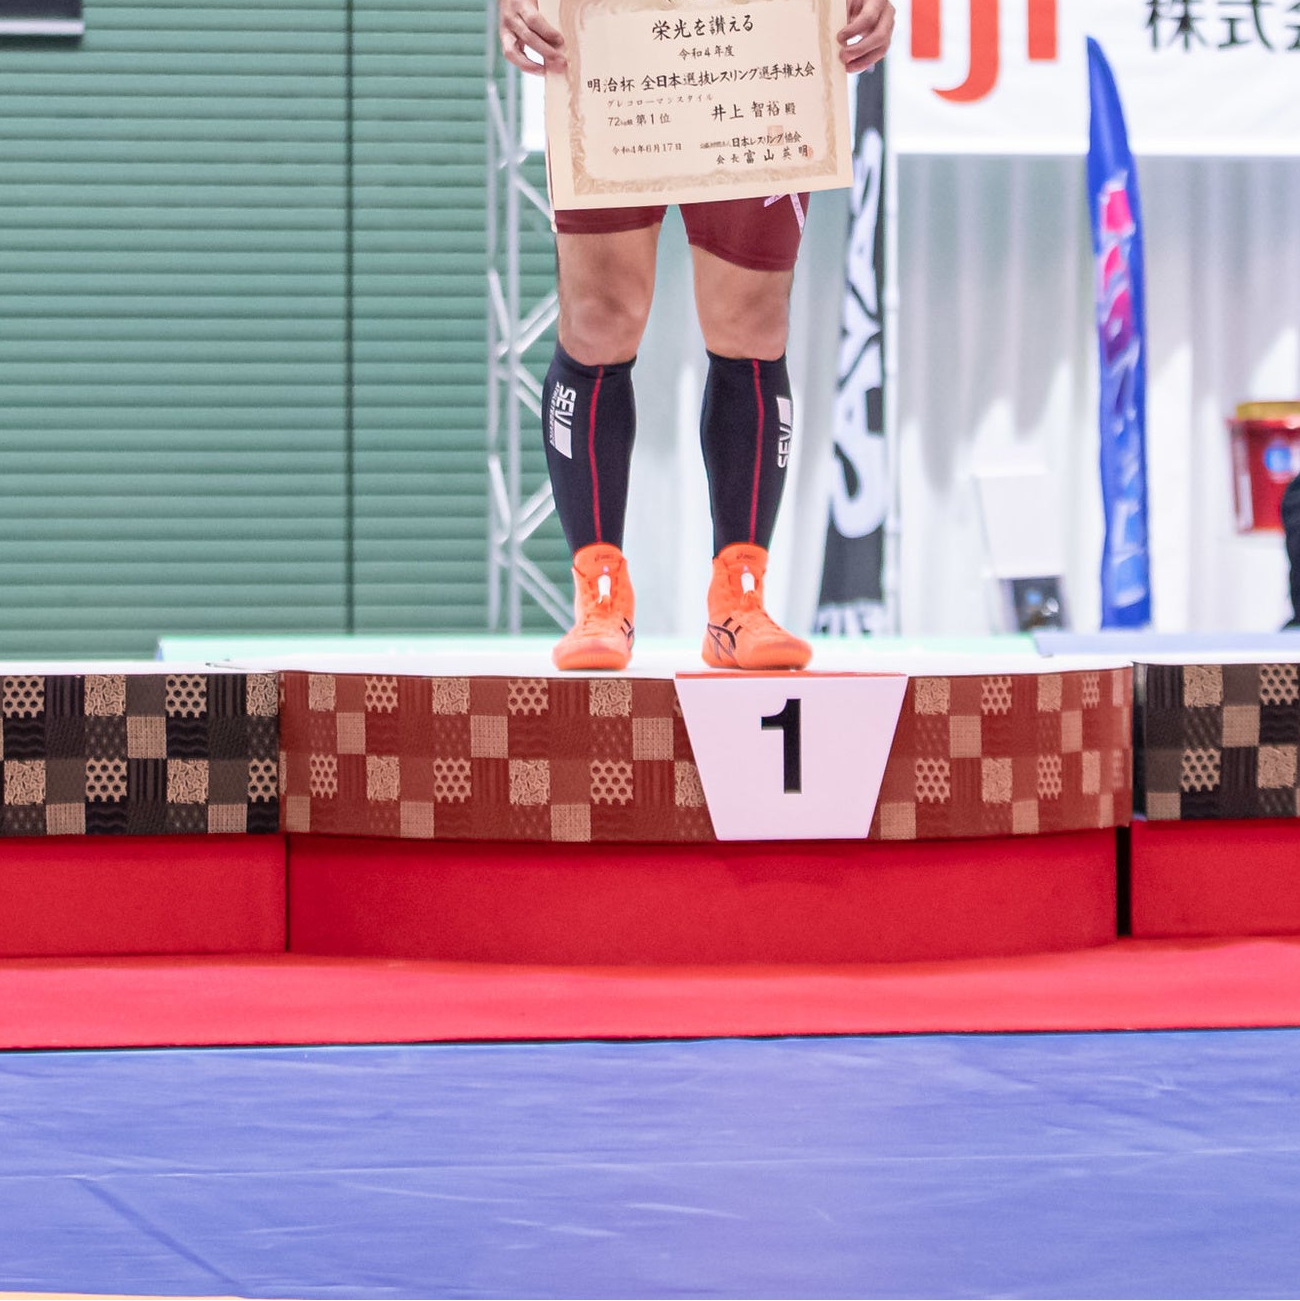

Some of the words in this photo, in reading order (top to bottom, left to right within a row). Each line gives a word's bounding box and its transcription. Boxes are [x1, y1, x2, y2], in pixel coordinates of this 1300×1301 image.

[651, 14, 754, 42] 栄光を讃える
[678, 44, 735, 61] 令和4年度
[586, 75, 636, 94] 明治杯
[641, 61, 815, 91] 全日本選抜レスリング選手権大会
[711, 102, 745, 122] 井上
[751, 100, 781, 117] 智裕
[555, 385, 578, 425] SEV
[761, 698, 802, 794] 1
